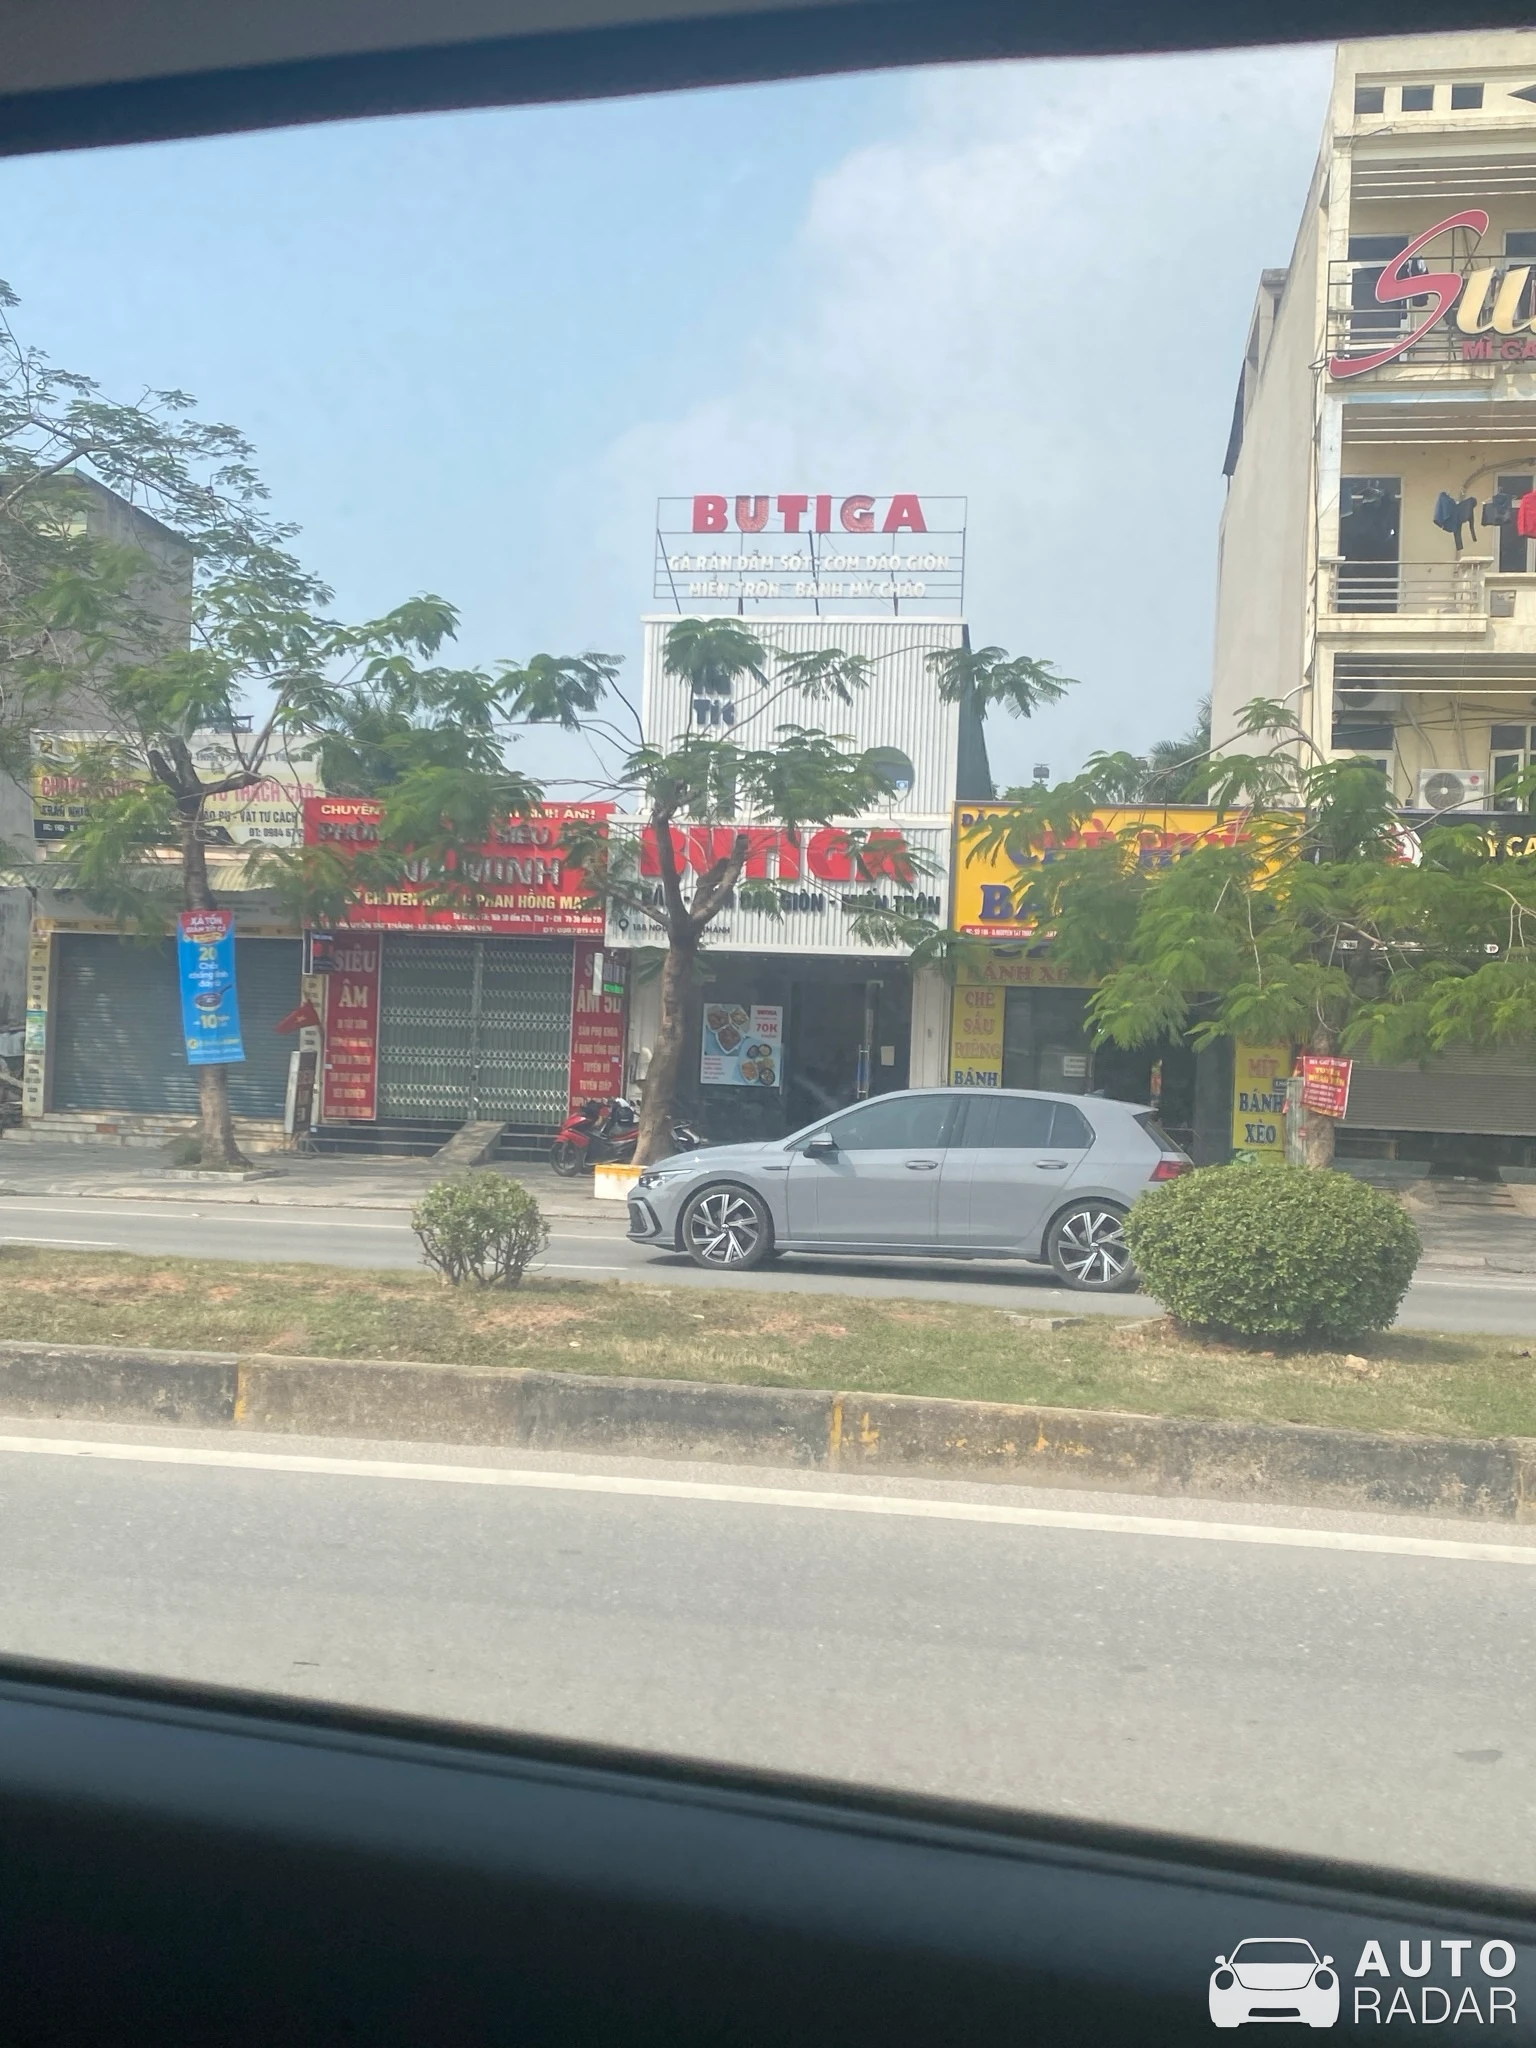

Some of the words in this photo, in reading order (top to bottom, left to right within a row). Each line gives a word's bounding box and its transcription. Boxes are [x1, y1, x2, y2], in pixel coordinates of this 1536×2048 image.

[1329, 208, 1536, 378] Su
[692, 494, 928, 533] BUTIGA
[321, 803, 381, 816] CHUYÊN
[518, 888, 556, 910] HỒNG
[334, 944, 376, 973] SIÊU
[338, 978, 368, 1008] ÂM
[576, 984, 600, 1013] ÂM
[200, 1014, 218, 1029] 10
[756, 1018, 778, 1032] 70K
[953, 1067, 998, 1086] BÁNH
[1239, 1088, 1285, 1113] BÁNH
[1244, 1119, 1277, 1144] XÈO
